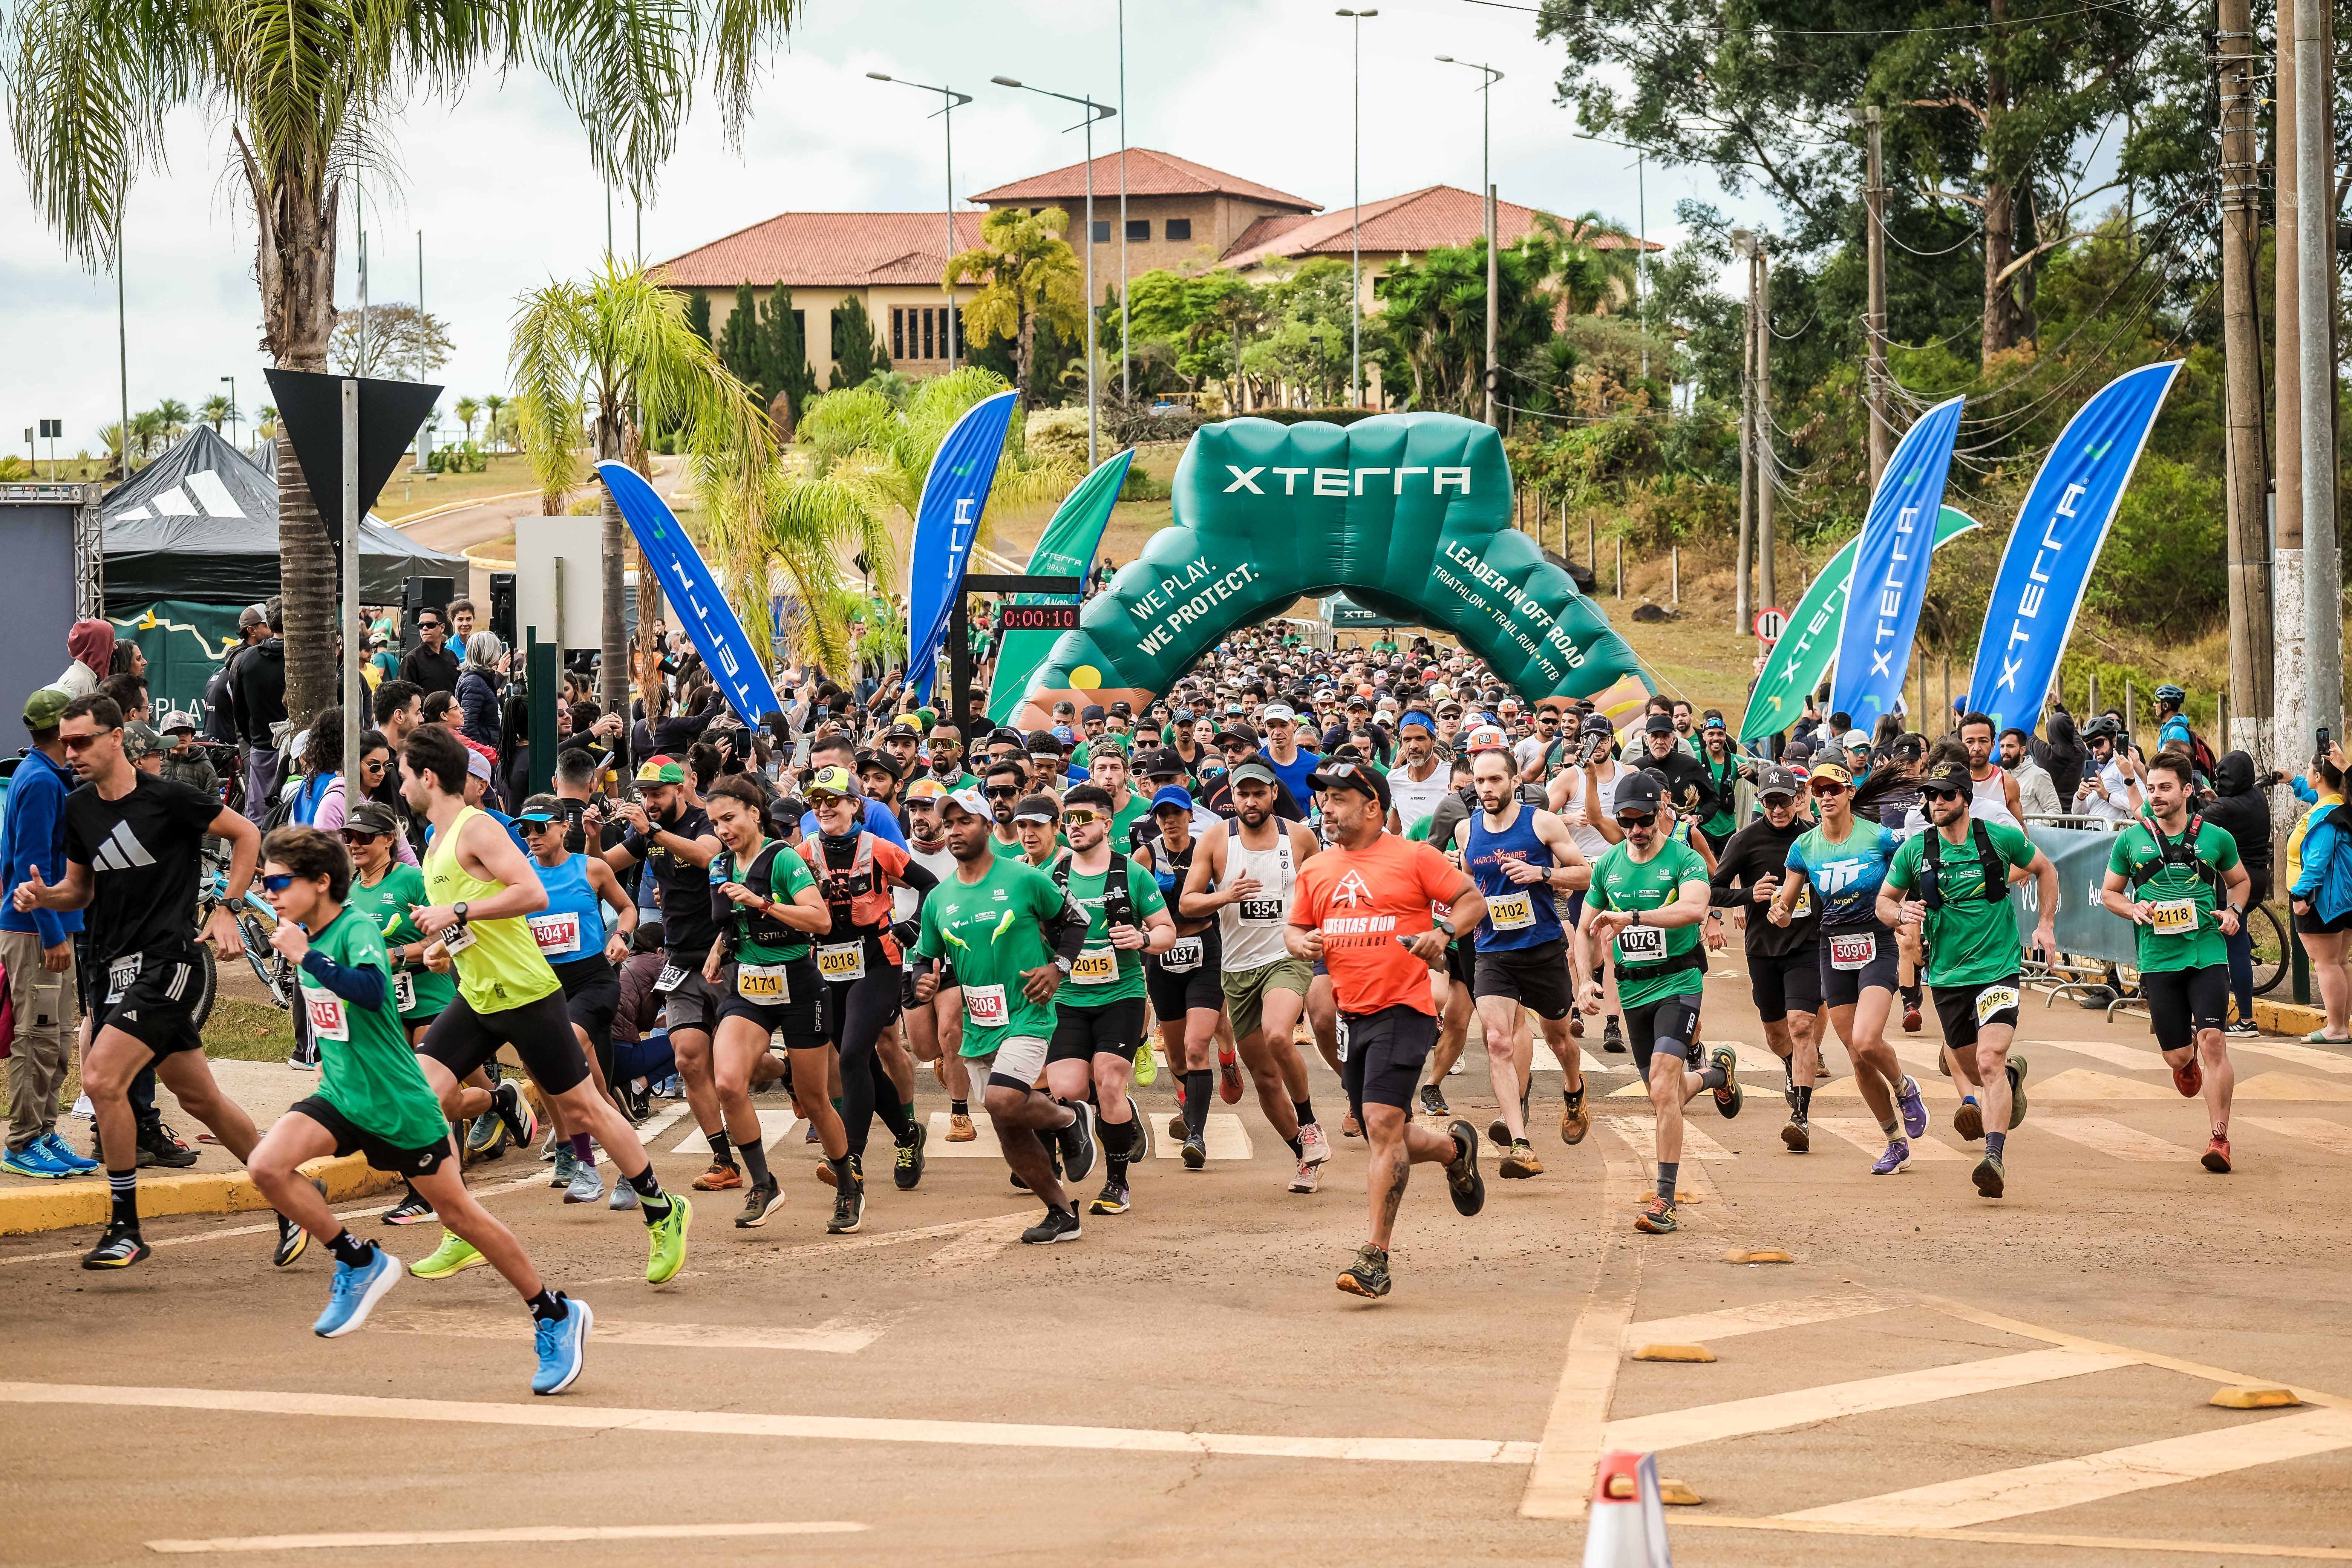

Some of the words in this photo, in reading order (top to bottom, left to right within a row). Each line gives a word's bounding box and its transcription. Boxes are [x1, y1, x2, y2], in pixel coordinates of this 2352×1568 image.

[1222, 465, 1471, 496] XTERRA
[1040, 551, 1082, 566] XTERRA
[1046, 563, 1067, 575] BRAZIL
[1131, 589, 1167, 620] WE
[1161, 556, 1216, 599] PLAY.
[1871, 507, 1919, 678] XTERRA
[1997, 483, 2086, 693] XTERRA
[1137, 624, 1174, 656] WE
[1166, 562, 1259, 633] PROTECT.
[1445, 540, 1508, 592] LEADER
[1504, 585, 1527, 606] IN
[1521, 600, 1555, 628] OFF
[1546, 625, 1585, 669] ROAD
[1004, 611, 1073, 627] 0:00:10
[1432, 565, 1487, 609] TRIATHLON
[1491, 609, 1519, 637] TRAIL
[1516, 633, 1539, 655] RUN
[1538, 658, 1559, 681] MTB
[1473, 855, 1497, 865] MARCIO
[793, 868, 803, 877] WE
[1682, 867, 1690, 877] WE
[1147, 894, 1157, 902] WE
[1244, 901, 1279, 915] 1354
[1493, 903, 1524, 918] 2102
[2157, 908, 2188, 922] 2118
[1369, 916, 1396, 932] RUN
[537, 923, 569, 942] 5041
[759, 931, 787, 940] ESTILO
[1622, 932, 1656, 948] 1078
[1165, 947, 1194, 962] 1037
[1837, 943, 1867, 958] 5090
[823, 953, 855, 969] 2018
[1075, 959, 1108, 971] 2015
[113, 968, 135, 988] 1186
[744, 976, 776, 990] 2171
[968, 997, 996, 1013] 5208
[1981, 992, 2009, 1013] 2096
[1686, 1012, 1695, 1034] TEO
